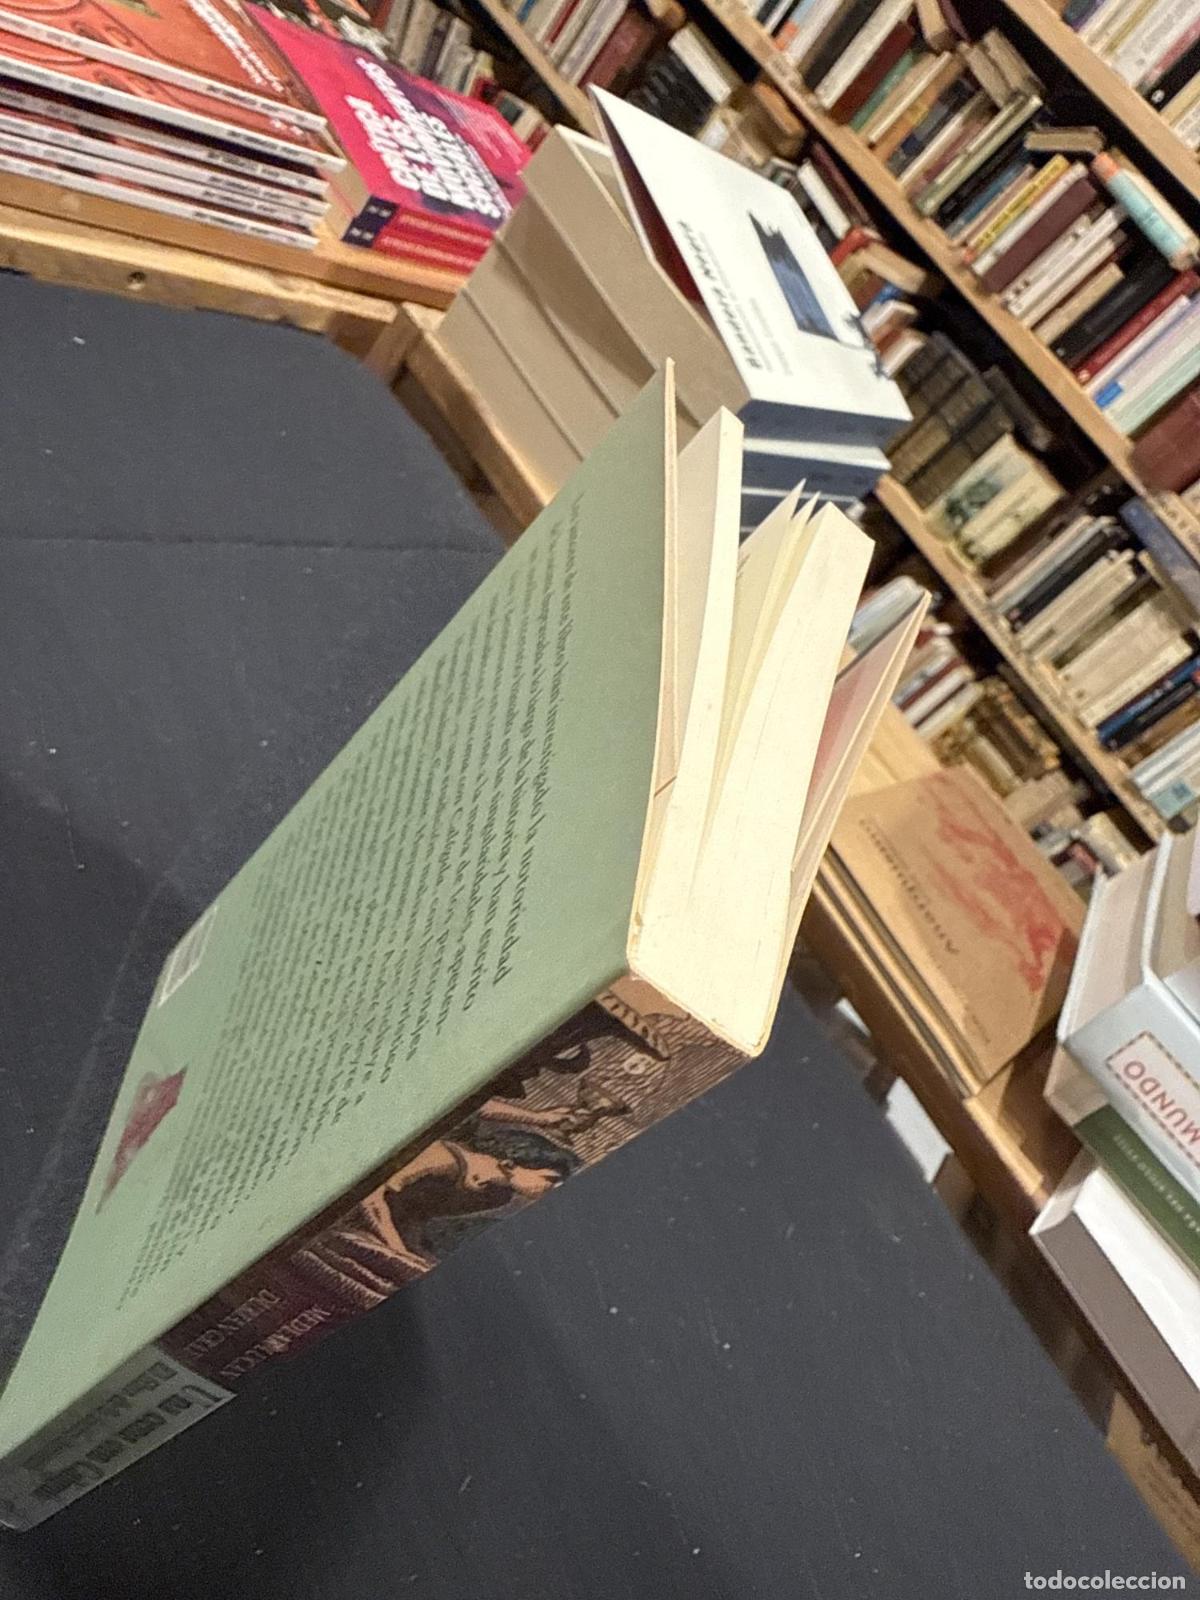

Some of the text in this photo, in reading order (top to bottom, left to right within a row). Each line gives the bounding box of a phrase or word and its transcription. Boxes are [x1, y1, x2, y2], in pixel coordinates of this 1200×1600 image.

[548, 659, 568, 706] han
[553, 615, 574, 671] libro
[528, 695, 563, 822] investigado
[457, 802, 479, 862] mesa
[497, 774, 530, 865] historia
[524, 811, 546, 846] la
[454, 784, 504, 948] singularidades,
[483, 872, 510, 928] han
[491, 840, 537, 988] notoriedad
[376, 933, 434, 1090] humorístico
[402, 925, 451, 1066] personajes
[434, 940, 468, 1038] apeten-
[461, 922, 495, 1015] escrito
[1123, 1059, 1200, 1145] MUNDO
